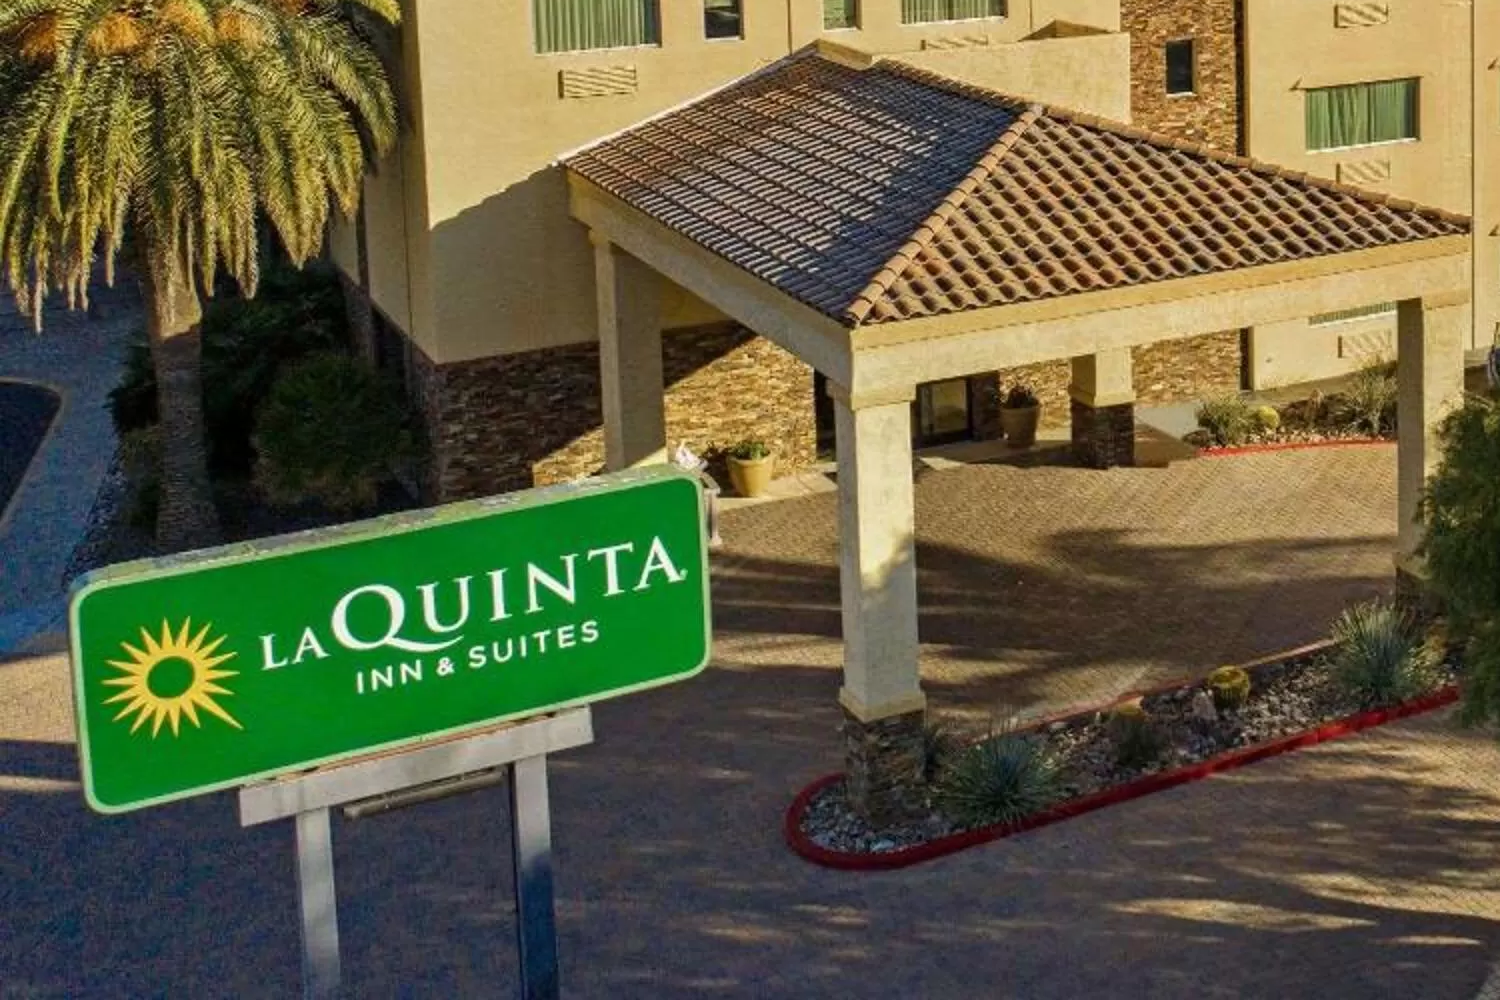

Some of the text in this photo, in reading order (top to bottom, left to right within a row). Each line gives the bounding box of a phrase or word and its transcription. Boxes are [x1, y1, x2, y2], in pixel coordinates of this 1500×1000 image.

[258, 535, 686, 671] LA QUINTA
[356, 619, 601, 695] INN & SUITES
